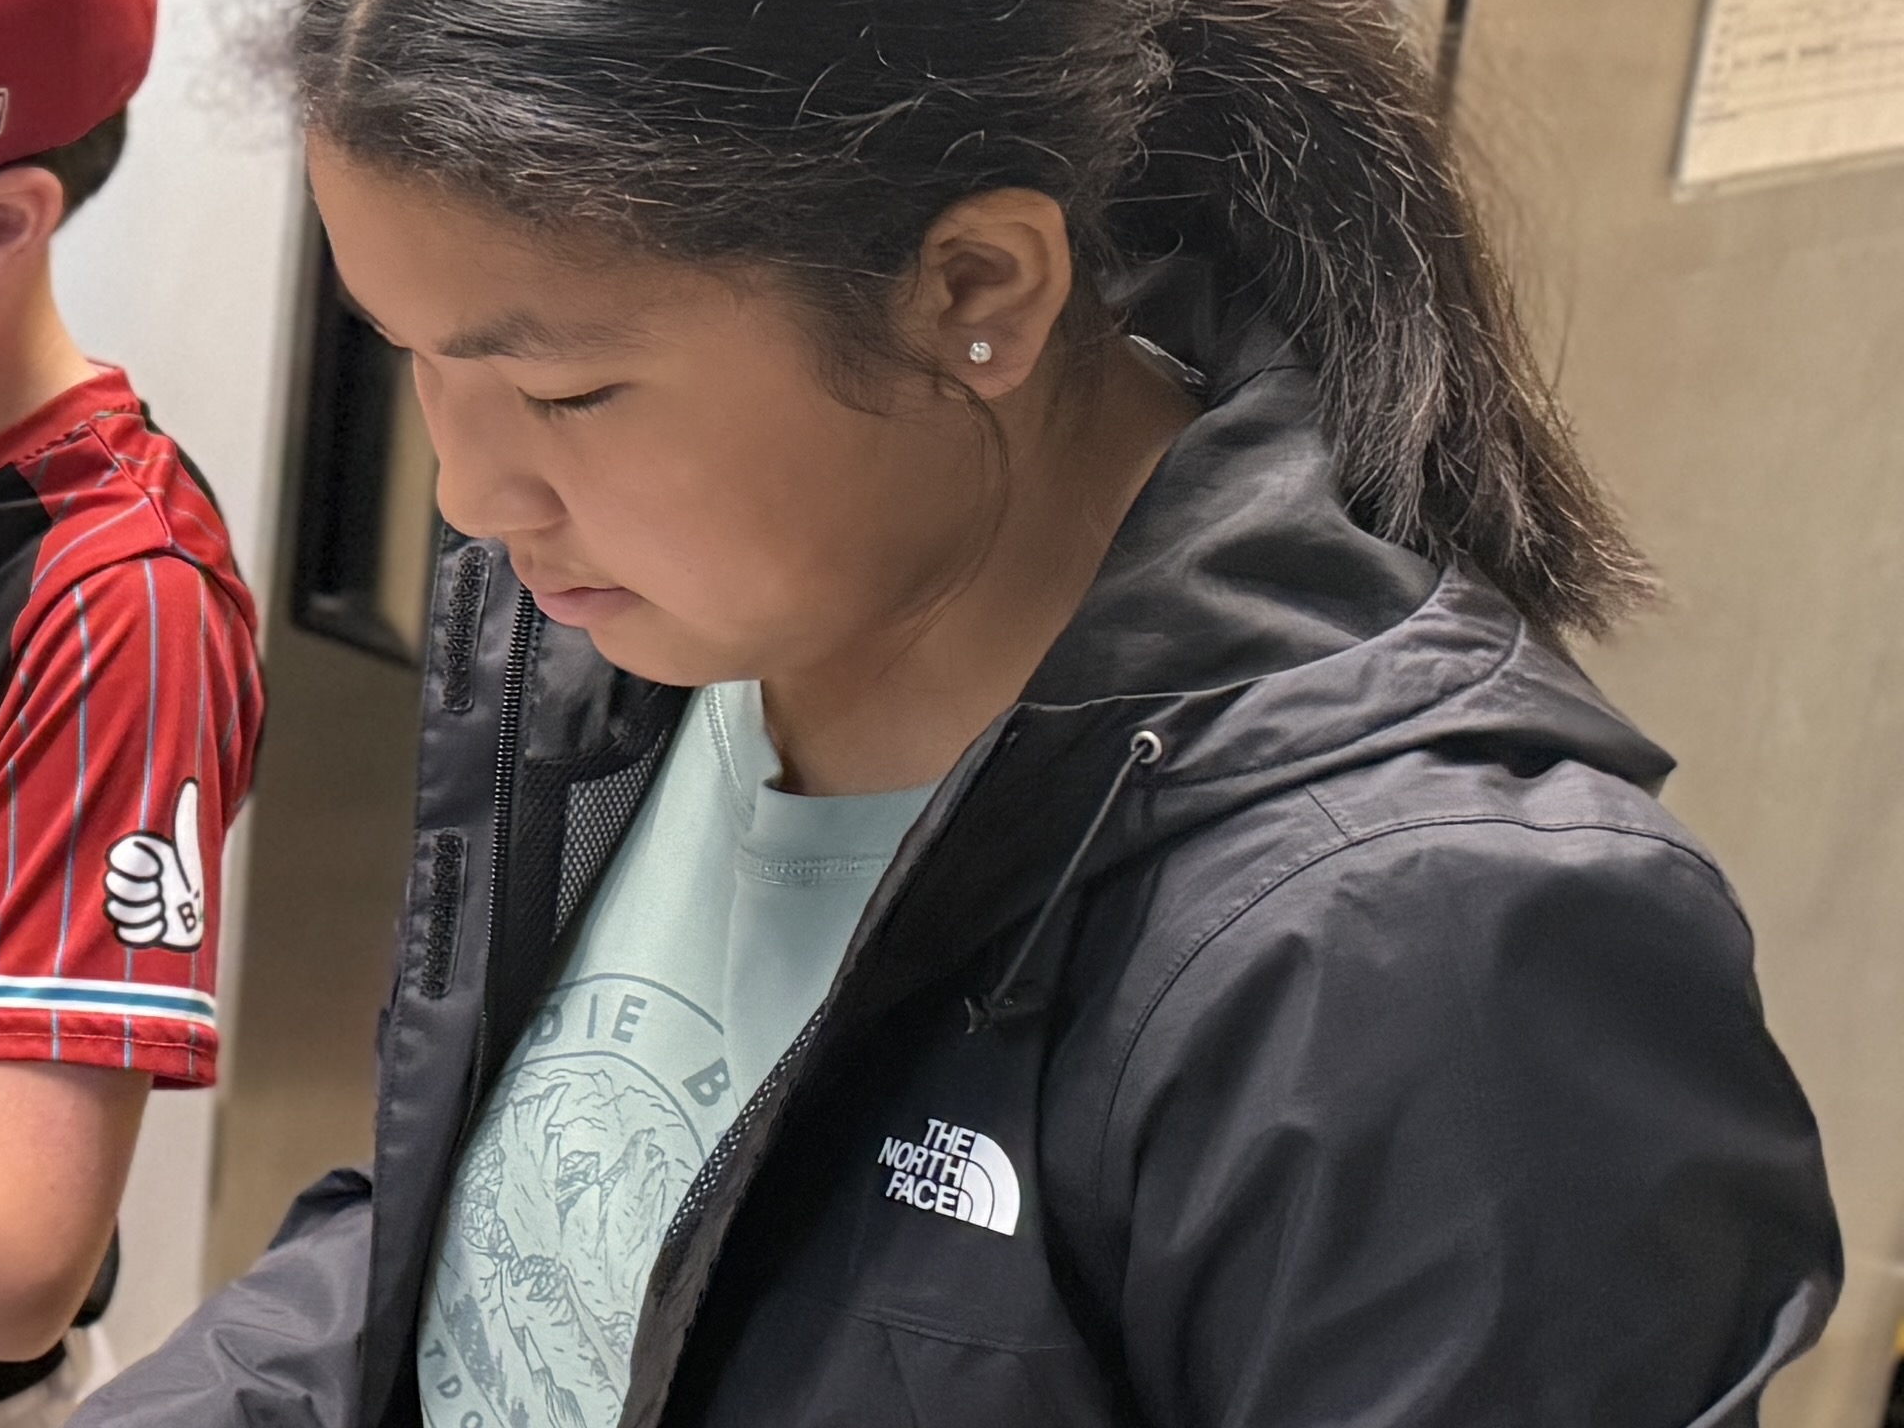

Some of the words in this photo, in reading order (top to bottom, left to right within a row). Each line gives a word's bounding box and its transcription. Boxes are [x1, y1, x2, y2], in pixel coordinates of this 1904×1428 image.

[877, 1136, 968, 1187] NORTH
[921, 1118, 976, 1159] THE
[885, 1170, 960, 1217] FACE
